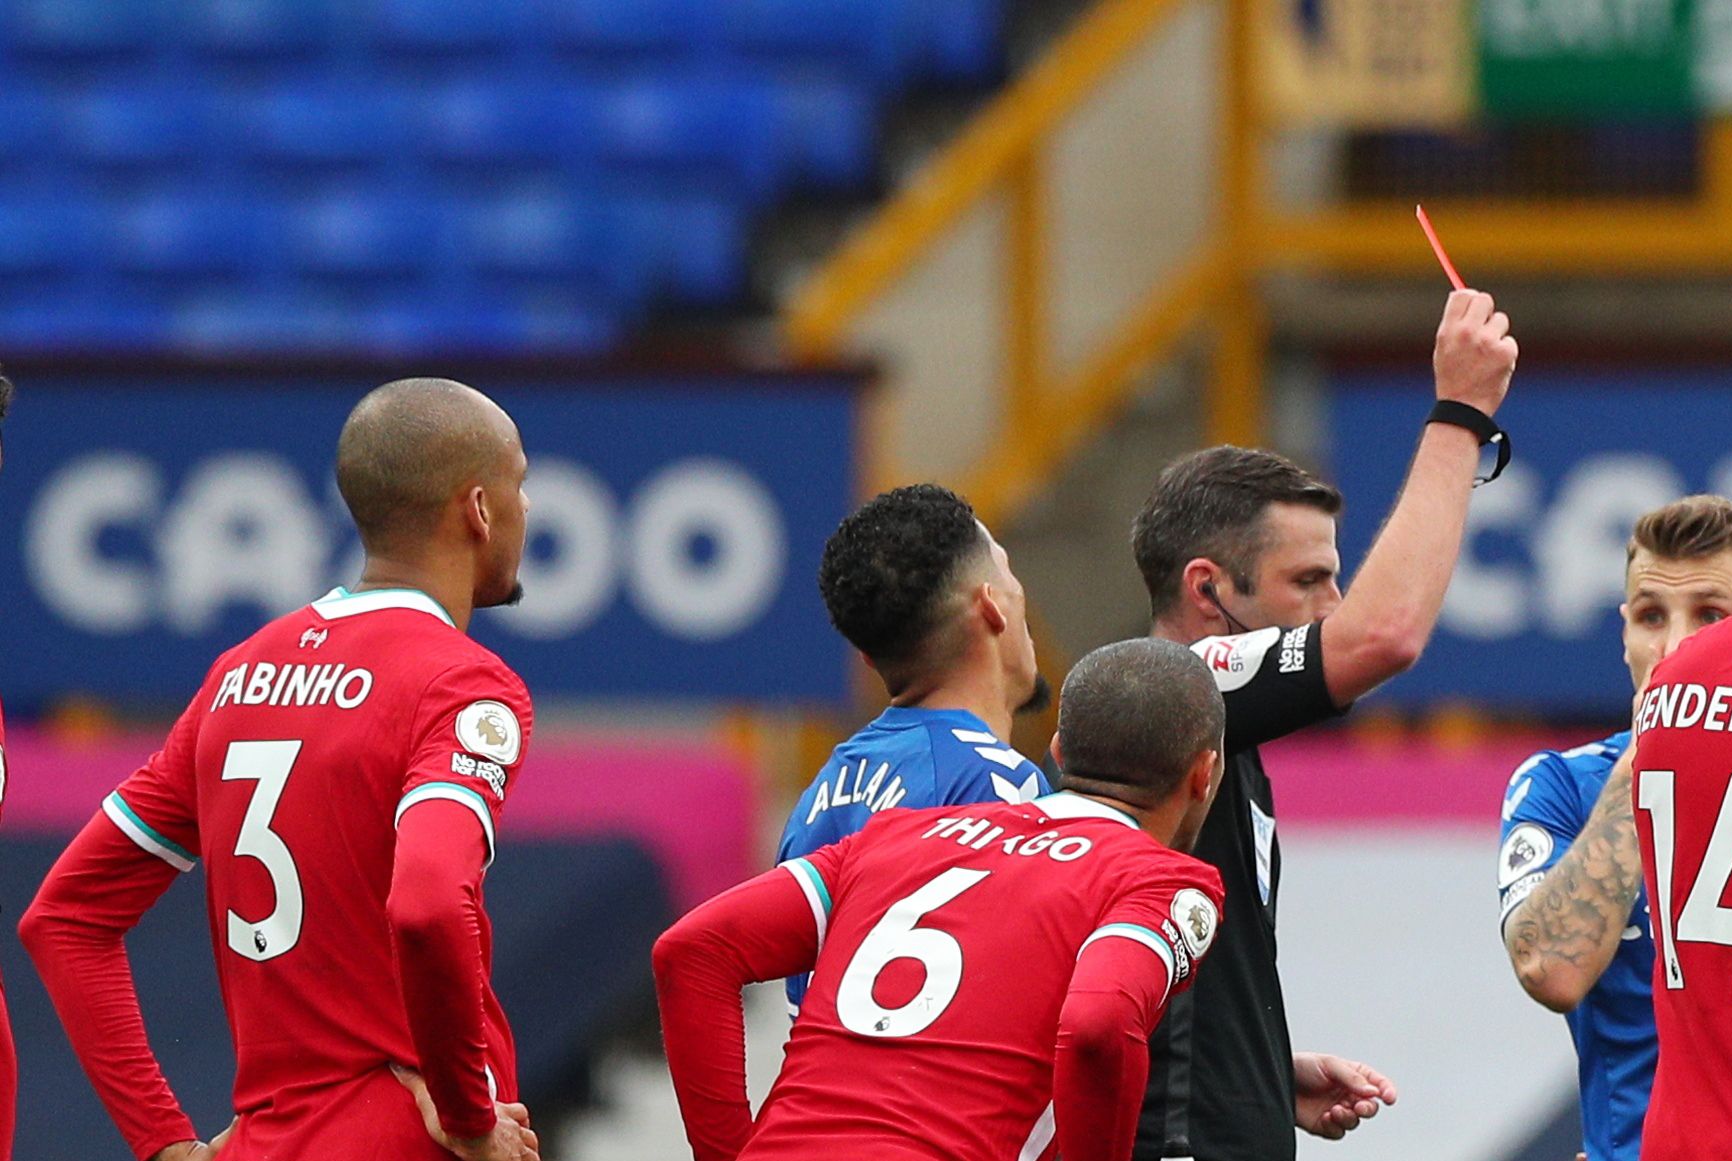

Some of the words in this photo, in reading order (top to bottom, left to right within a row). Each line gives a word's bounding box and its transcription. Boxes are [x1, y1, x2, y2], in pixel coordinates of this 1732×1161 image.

[28, 450, 786, 642] CAOO
[221, 739, 304, 963] 3
[805, 758, 907, 825] ALLAN
[836, 866, 992, 1038] 6
